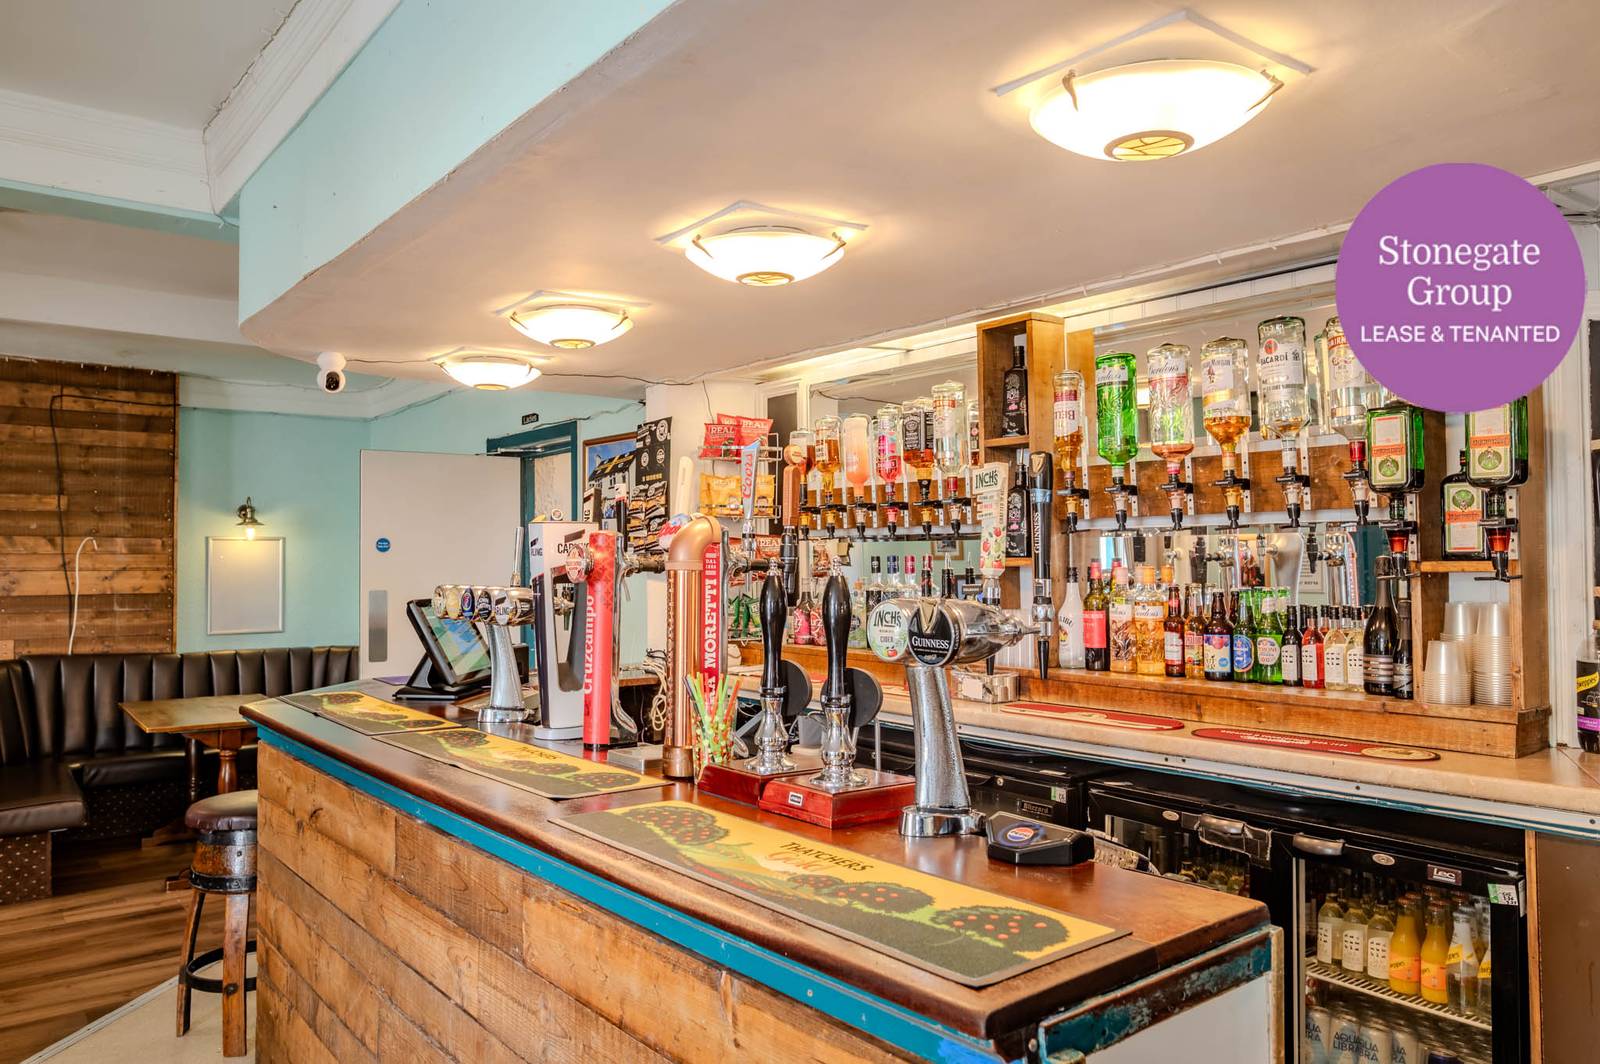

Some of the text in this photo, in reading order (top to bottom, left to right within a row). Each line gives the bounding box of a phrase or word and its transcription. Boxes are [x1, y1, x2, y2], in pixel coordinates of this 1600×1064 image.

[710, 426, 736, 434] REAL
[1033, 511, 1042, 555] GUINNESS
[704, 578, 717, 670] MORETTI
[911, 635, 950, 650] GUINNESS
[779, 842, 875, 872] THATCHERS
